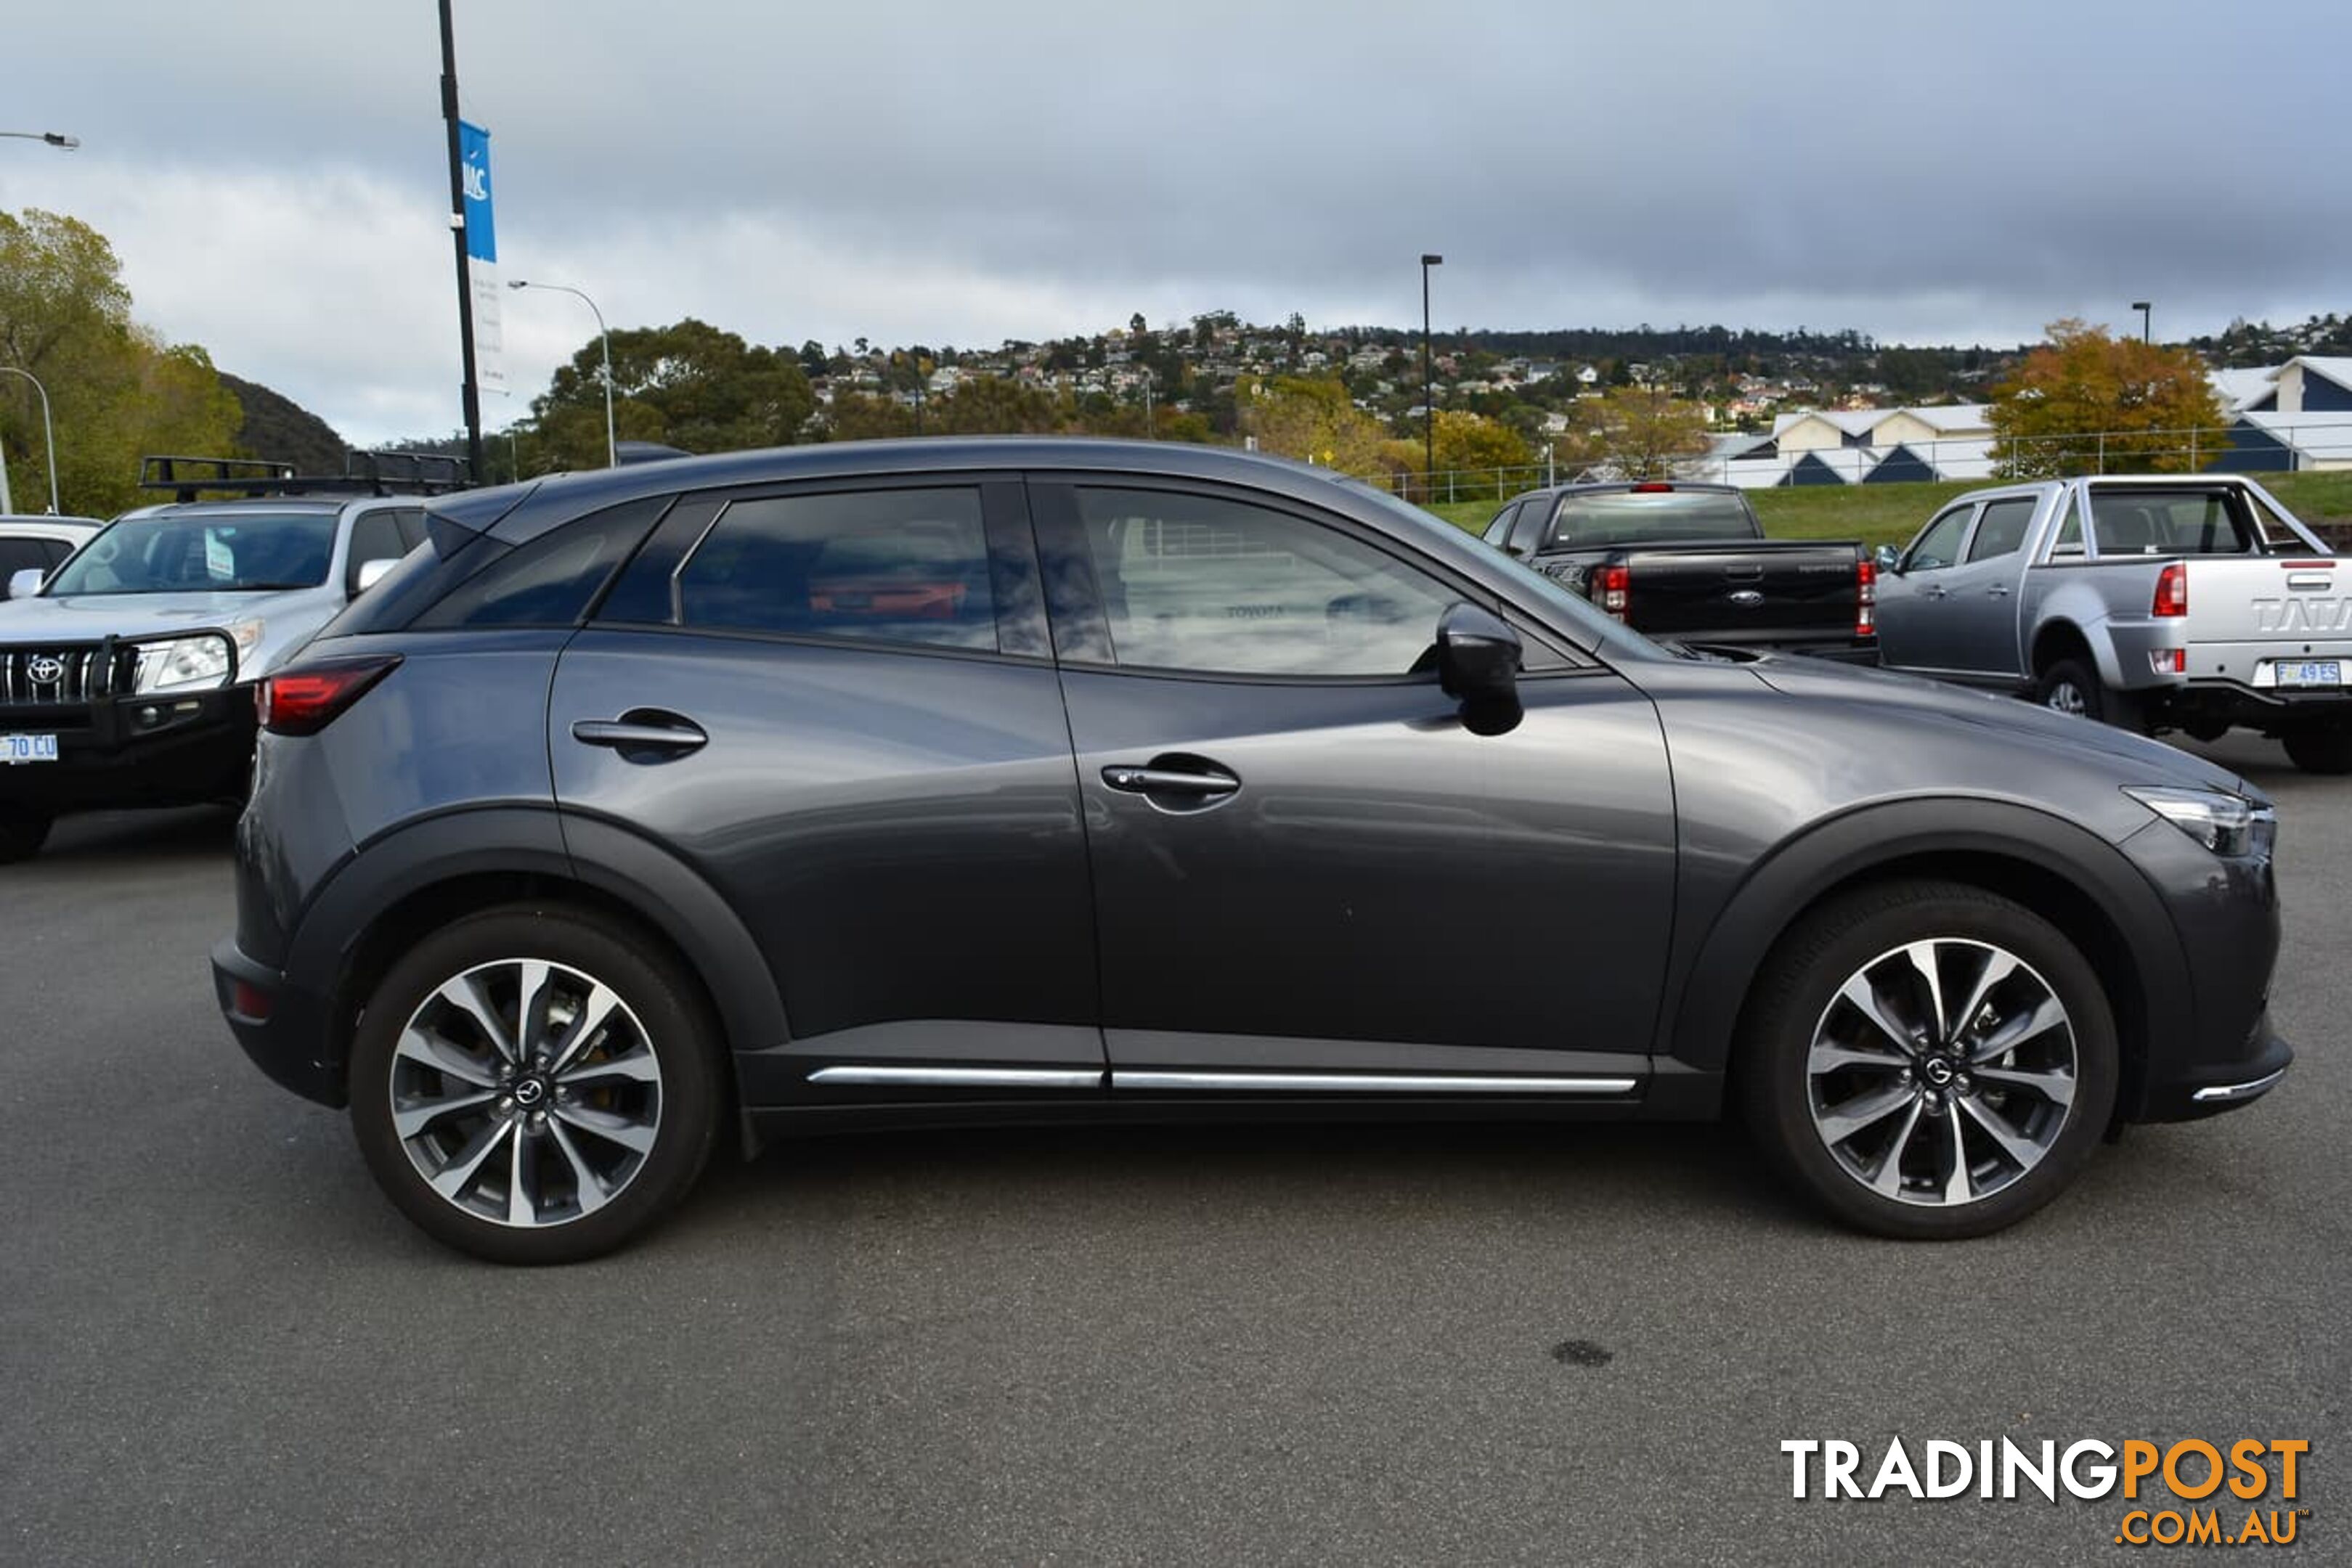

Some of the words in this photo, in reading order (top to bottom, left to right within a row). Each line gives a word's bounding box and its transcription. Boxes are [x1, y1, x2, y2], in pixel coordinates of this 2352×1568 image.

[1225, 604, 1284, 619] TOYOTA
[2250, 597, 2352, 631] TATA
[7, 738, 29, 756] 70
